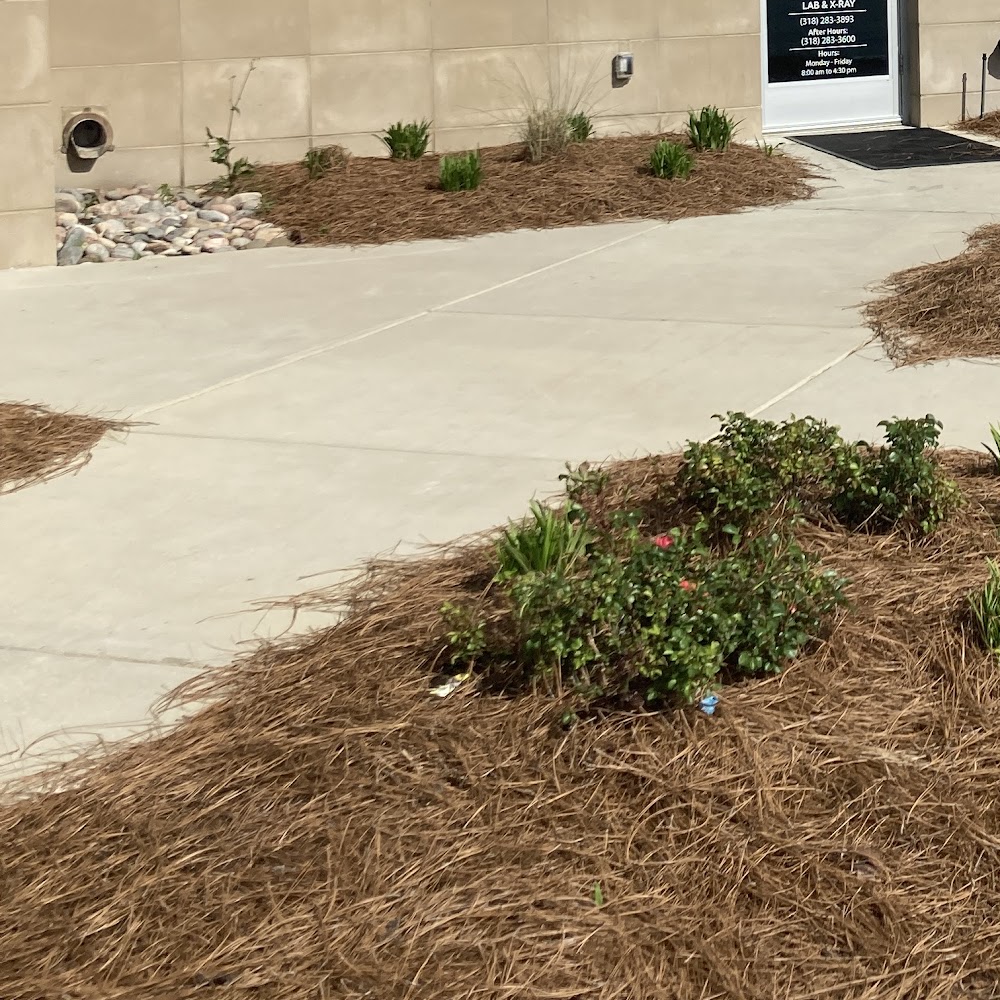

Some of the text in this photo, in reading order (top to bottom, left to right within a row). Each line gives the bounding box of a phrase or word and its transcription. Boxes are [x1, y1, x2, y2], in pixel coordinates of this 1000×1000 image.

[802, 0, 856, 10] LAB & X-RAY
[800, 15, 854, 26] (318) 283-3893
[801, 35, 856, 46] (318) 283-3600
[805, 59, 830, 67] Monday
